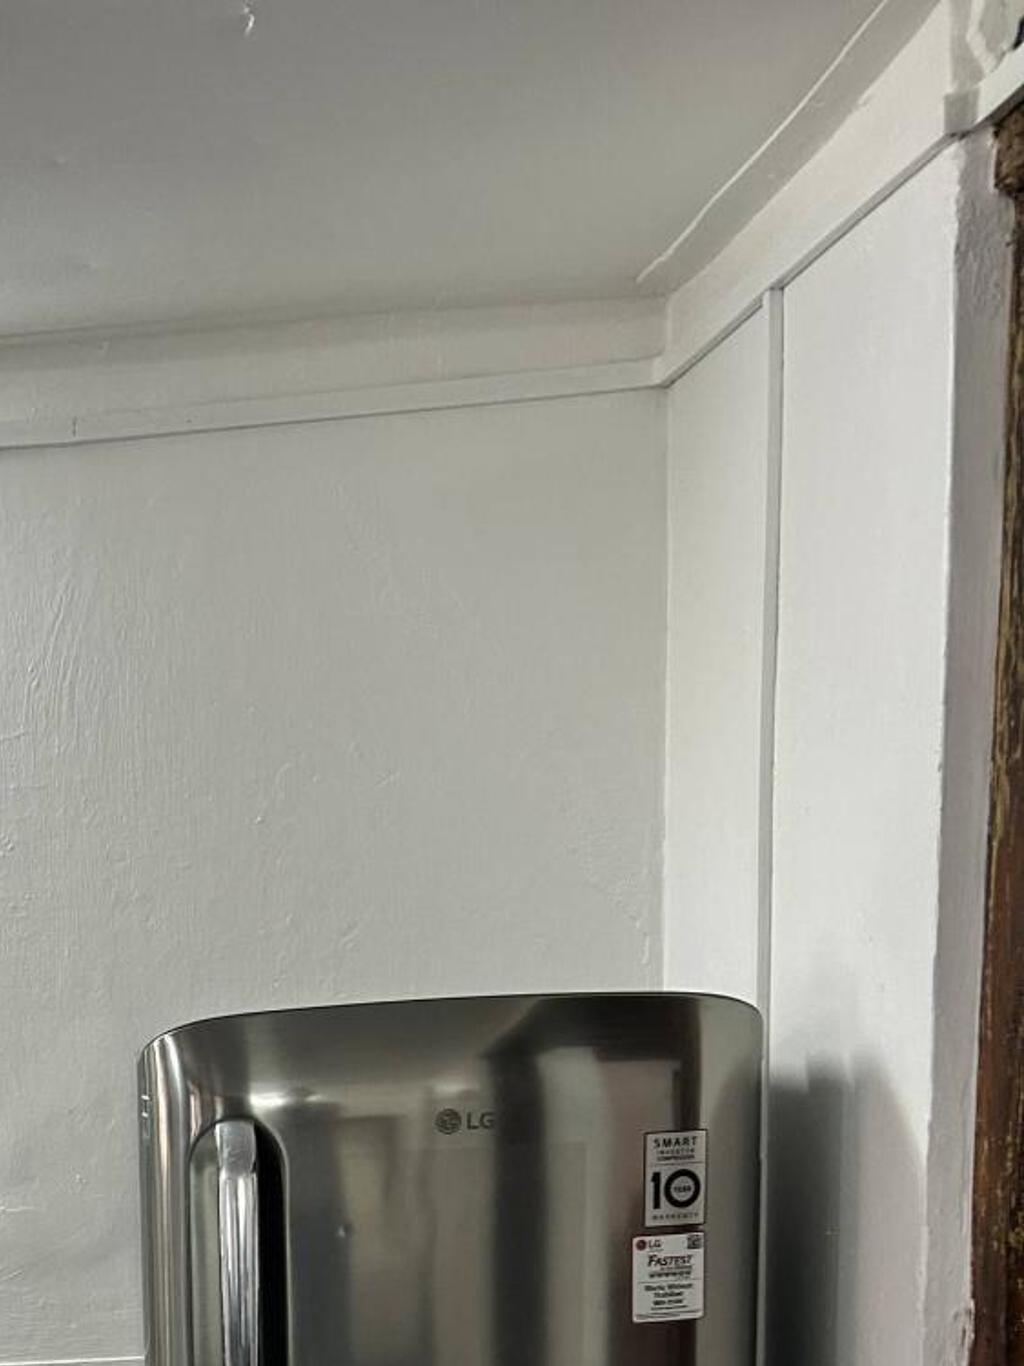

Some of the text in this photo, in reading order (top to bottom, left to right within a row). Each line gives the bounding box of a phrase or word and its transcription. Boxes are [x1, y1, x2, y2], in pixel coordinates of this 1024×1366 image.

[466, 1111, 496, 1130] LG
[653, 1136, 697, 1149] SMART
[651, 1168, 701, 1210] 10
[648, 1239, 661, 1248] LG
